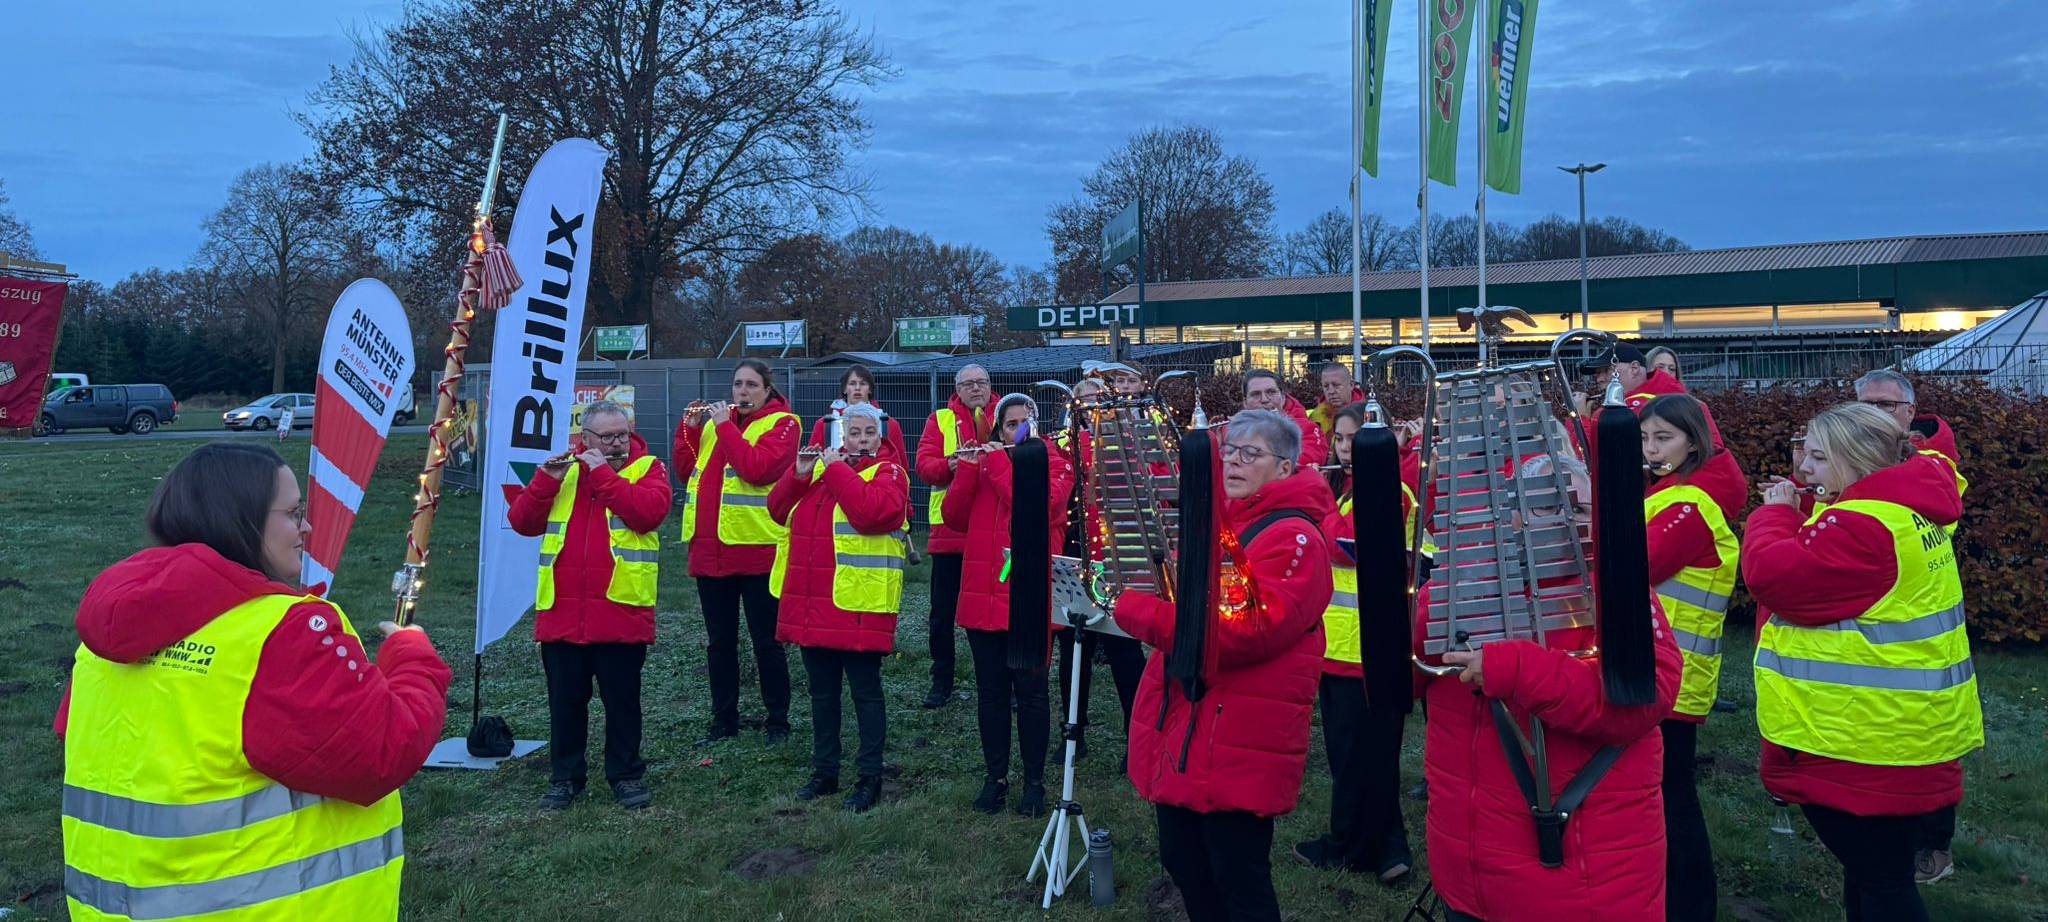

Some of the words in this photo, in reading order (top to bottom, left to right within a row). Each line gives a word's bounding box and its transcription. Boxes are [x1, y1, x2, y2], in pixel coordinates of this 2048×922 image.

[351, 308, 405, 370] ANTENNE
[510, 204, 585, 451] Brillux
[1038, 304, 1140, 327] DEPOT
[337, 363, 352, 381] DER
[351, 376, 369, 401] BESTE
[346, 323, 399, 385] MÜNSTER
